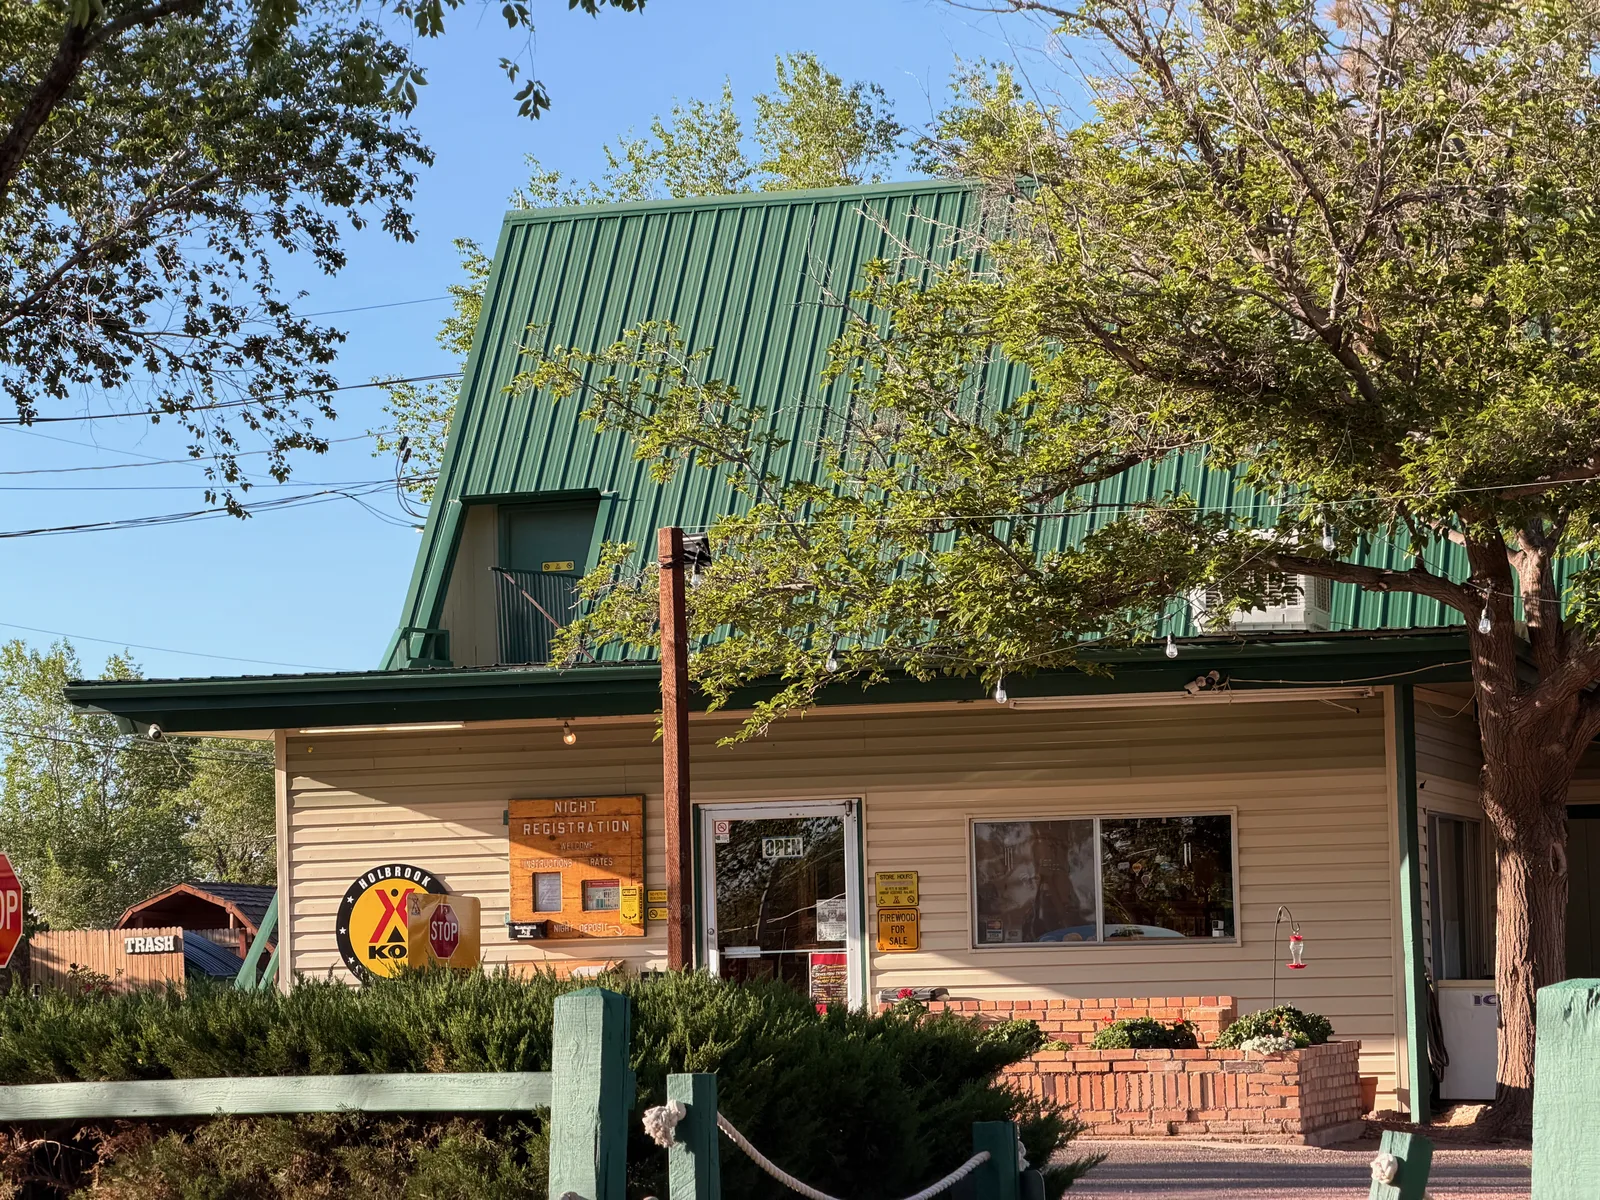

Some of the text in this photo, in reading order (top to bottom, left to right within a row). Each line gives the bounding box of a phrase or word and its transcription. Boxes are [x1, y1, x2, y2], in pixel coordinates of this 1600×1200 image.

[554, 801, 597, 813] NIGHT
[523, 820, 630, 835] REGISTRATION
[561, 841, 594, 850] WELCOME
[766, 839, 801, 857] OPEN
[523, 859, 573, 869] INSTRUCTIONS
[590, 857, 613, 867] RATES
[358, 866, 432, 890] HOLBROOK
[880, 913, 916, 922] FIREWOOD
[430, 920, 458, 942] STOP
[553, 923, 608, 933] NIGHT DEPOSIT
[891, 925, 905, 934] FOR
[124, 935, 175, 953] TRASH
[889, 936, 908, 945] SALE
[368, 945, 408, 959] KO
[1474, 994, 1496, 1005] IC
